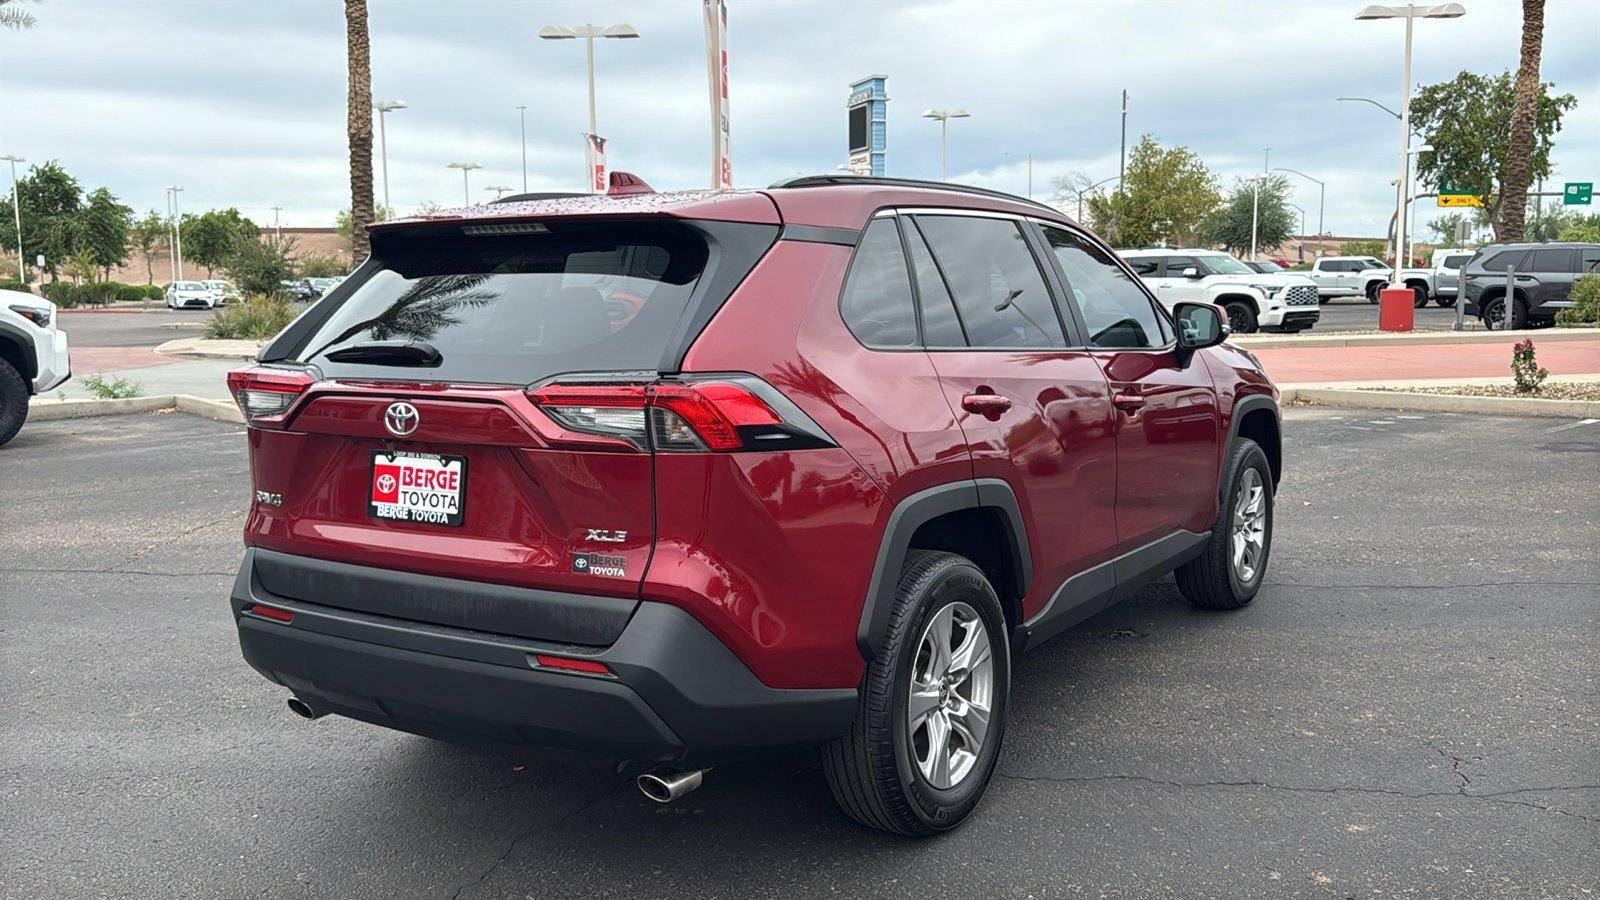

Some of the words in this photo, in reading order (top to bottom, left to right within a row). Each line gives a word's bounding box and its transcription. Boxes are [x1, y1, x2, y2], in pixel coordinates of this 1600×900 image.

[402, 466, 458, 491] BERGE
[401, 491, 458, 510] TOYOTA
[377, 505, 409, 520] BERGE
[411, 509, 449, 524] TOYOTA
[585, 529, 627, 542] XLE
[590, 553, 626, 567] BERGE
[589, 566, 625, 577] TOYOTA
